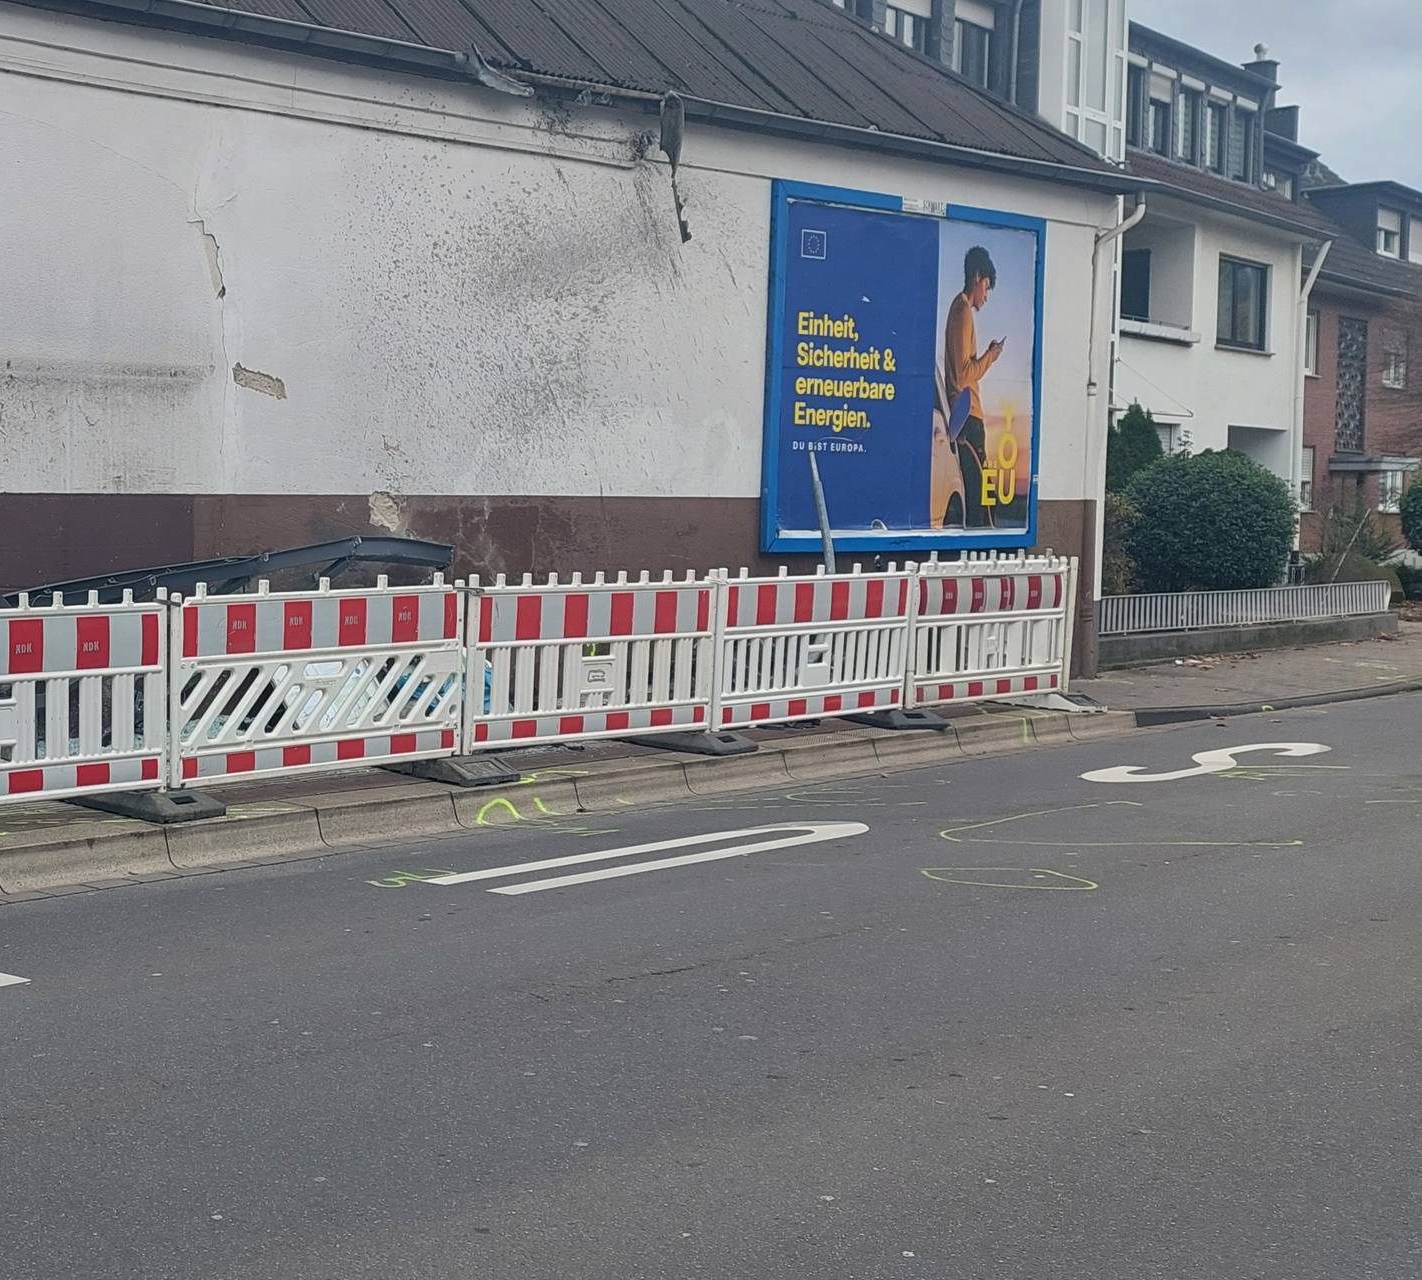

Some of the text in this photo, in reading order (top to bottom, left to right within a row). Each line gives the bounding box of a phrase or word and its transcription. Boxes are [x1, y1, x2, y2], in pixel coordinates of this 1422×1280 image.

[798, 311, 859, 342] Einheit,
[797, 342, 896, 371] Sicherheit &
[795, 376, 895, 400] erneuerbare
[794, 401, 871, 433] Energien.
[792, 441, 805, 450] DU
[830, 443, 867, 453] EUROPA.
[82, 641, 99, 652] NDK
